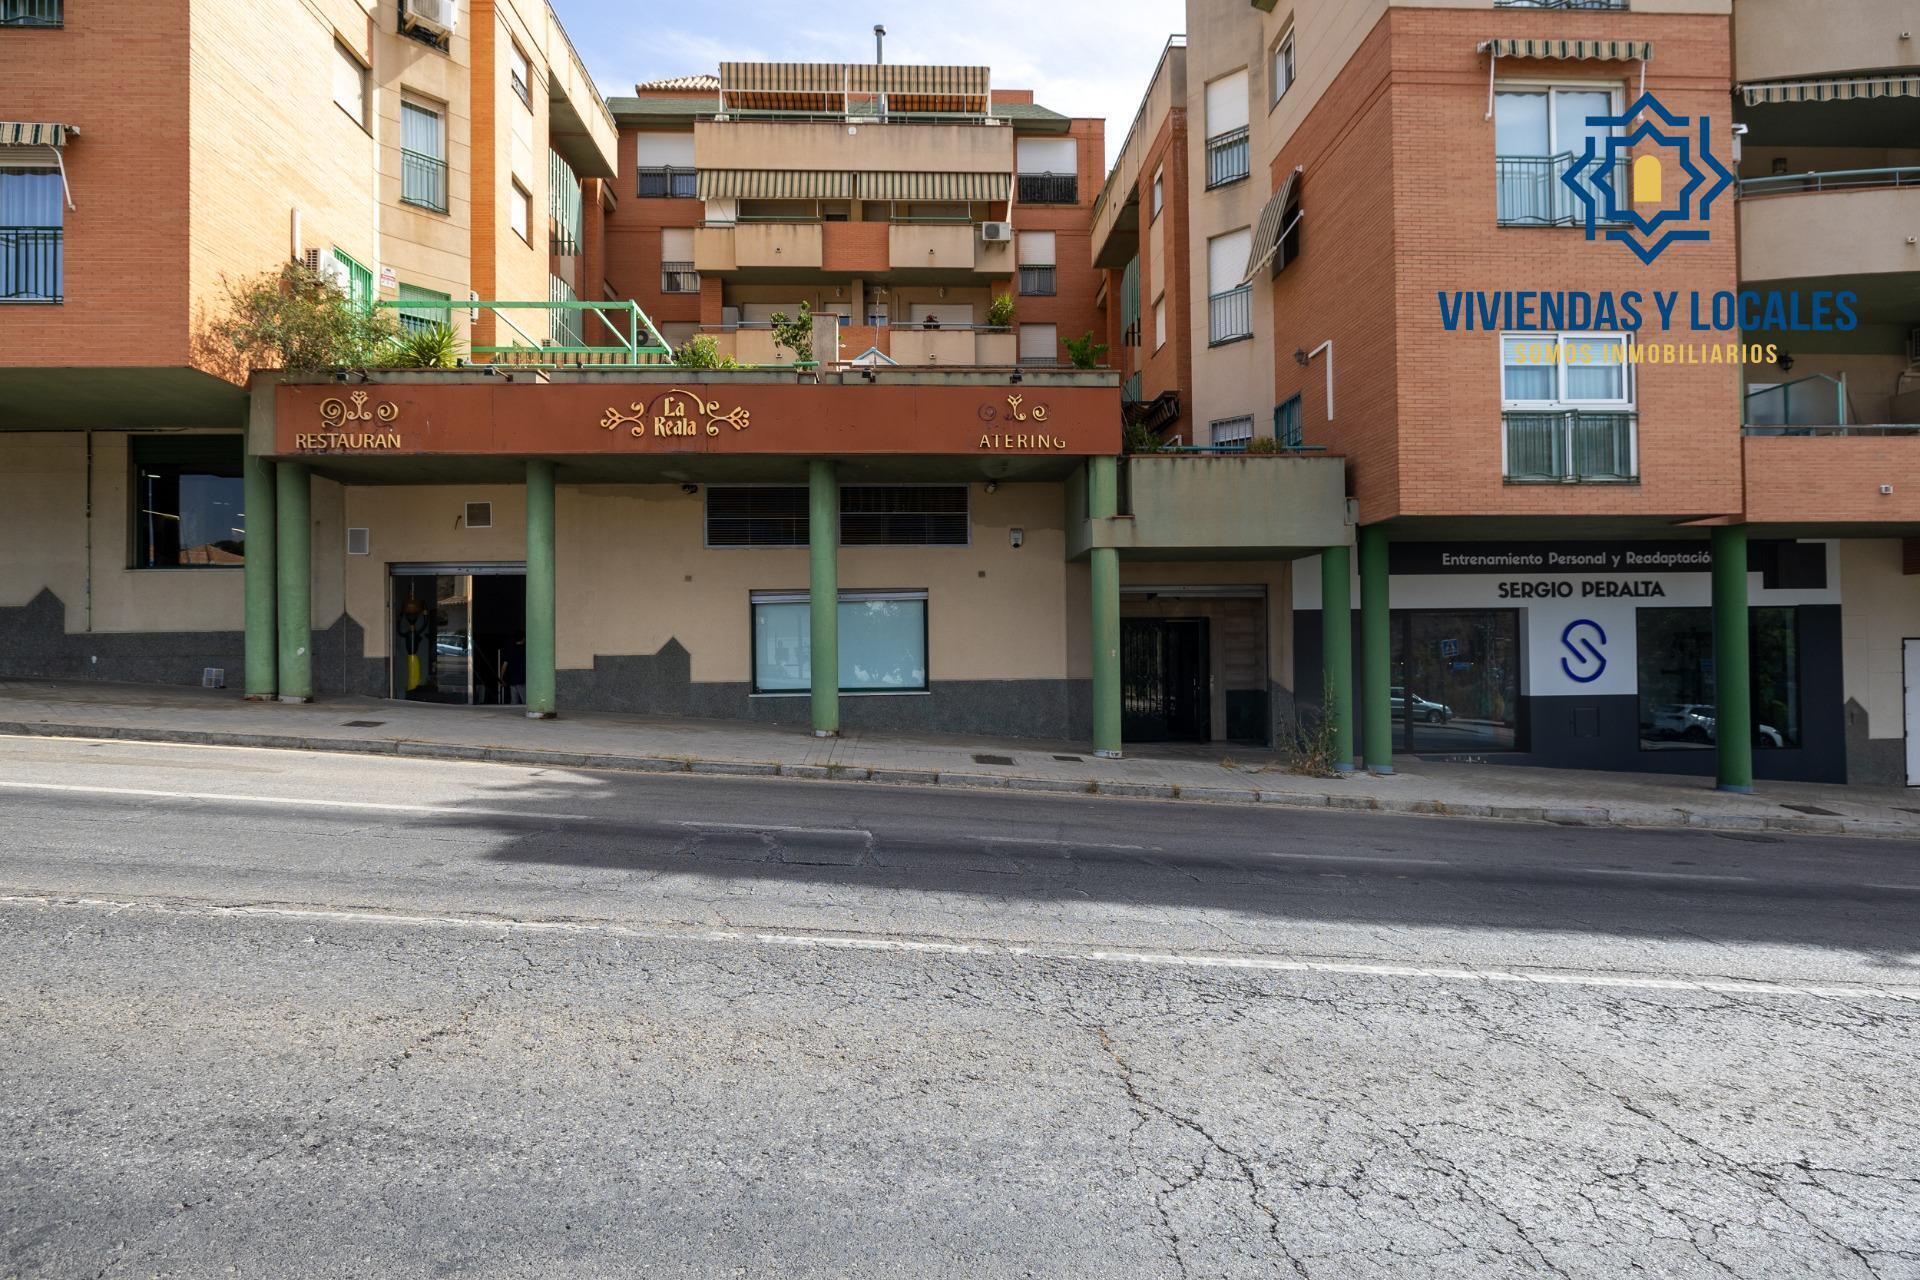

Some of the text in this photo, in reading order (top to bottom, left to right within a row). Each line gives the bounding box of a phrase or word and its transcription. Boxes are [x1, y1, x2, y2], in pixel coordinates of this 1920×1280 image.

[664, 396, 685, 417] La
[654, 416, 697, 438] Reala
[295, 432, 401, 449] RESTAURAN
[1442, 550, 1713, 568] Entrenamiento Personal y Readaptació
[1498, 581, 1666, 599] SERGIO PERALTA
